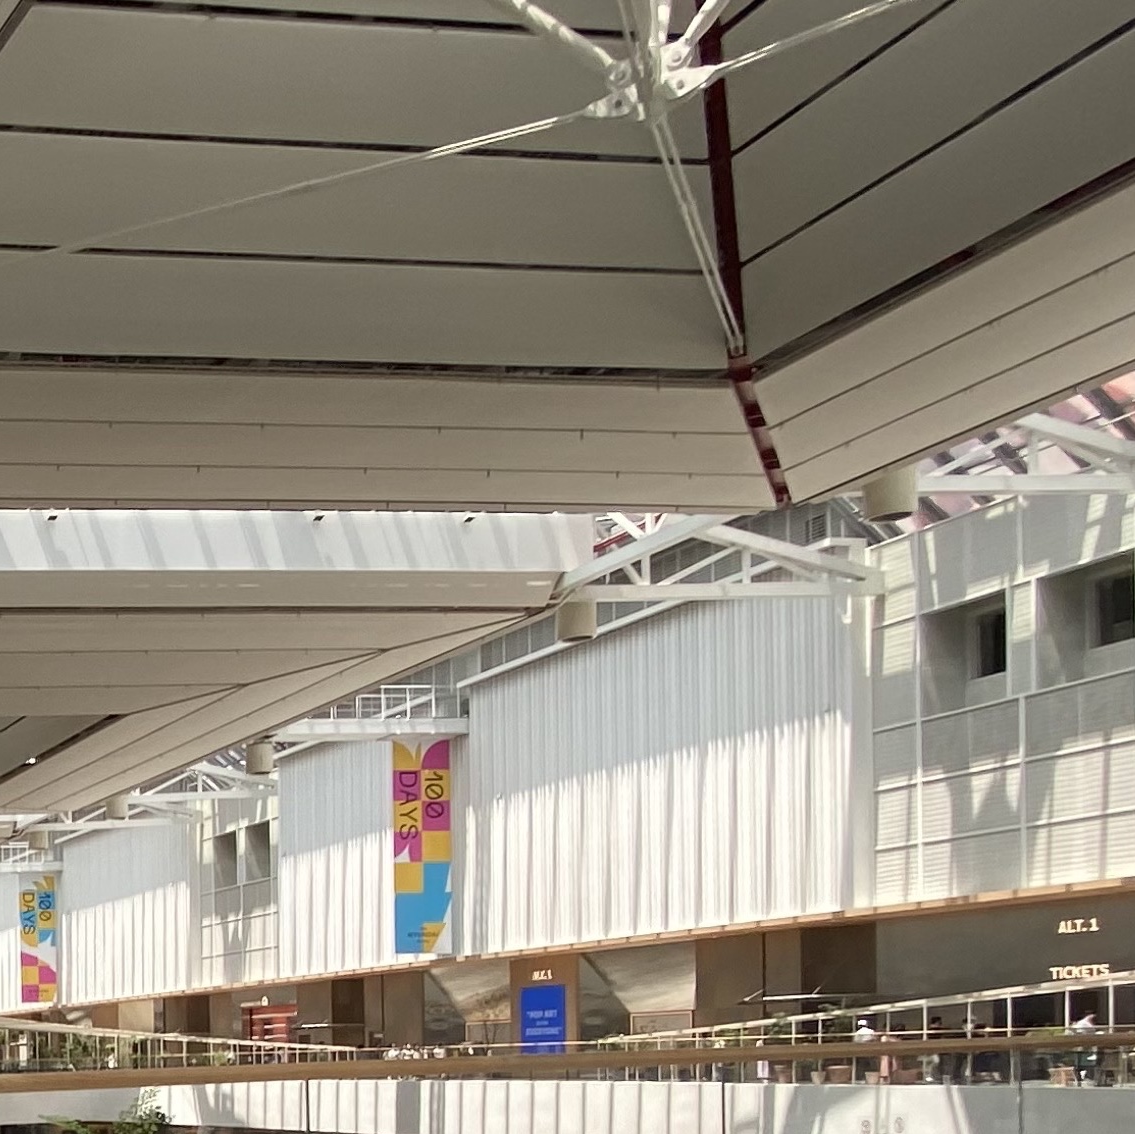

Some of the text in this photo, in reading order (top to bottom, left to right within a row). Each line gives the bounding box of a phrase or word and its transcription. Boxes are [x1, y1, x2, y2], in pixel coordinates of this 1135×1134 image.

[398, 771, 419, 840] DAYS
[424, 771, 444, 819] 100
[22, 892, 36, 935] DAYS
[38, 892, 52, 922] 100
[1049, 963, 1109, 980] TICKETS
